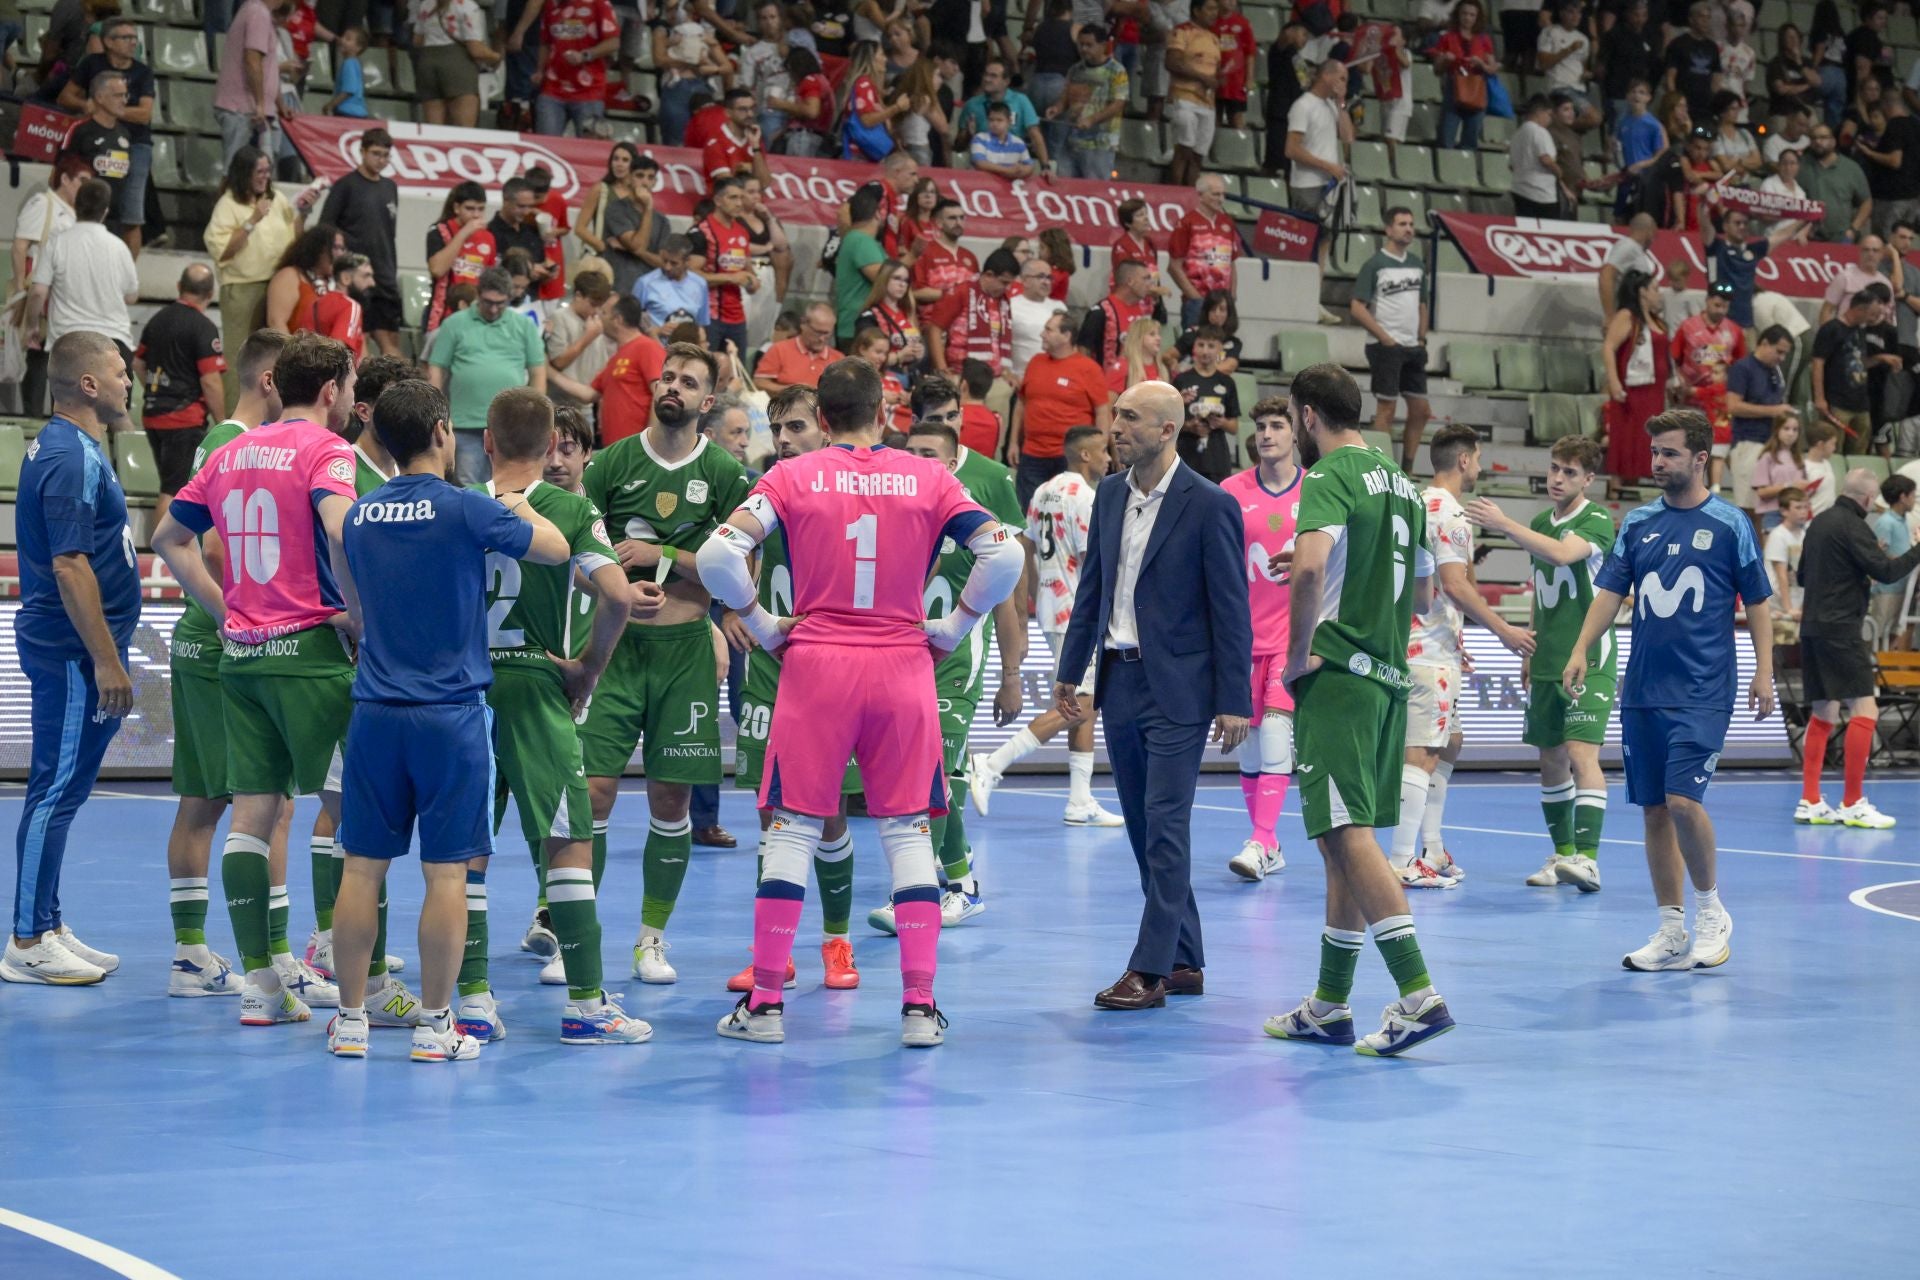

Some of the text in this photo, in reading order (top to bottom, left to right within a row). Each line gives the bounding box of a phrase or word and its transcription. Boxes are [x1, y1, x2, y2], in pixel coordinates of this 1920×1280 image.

[27, 124, 64, 142] MÓDU
[949, 179, 1002, 218] la
[1009, 179, 1184, 232] famia
[1264, 225, 1308, 246] MÓDULO
[219, 450, 230, 474] J.
[233, 441, 297, 472] MÍNGUEZ
[811, 471, 917, 496] J. HERRERO
[222, 488, 281, 584] 10
[846, 514, 877, 608] 1
[1667, 543, 1681, 556] TM
[485, 550, 525, 648] 2
[265, 640, 299, 657] ARDOZ
[739, 702, 771, 740] 20
[663, 747, 720, 757] FINANCIAL
[559, 942, 580, 951] ter
[411, 1042, 436, 1050] P-FLEX
